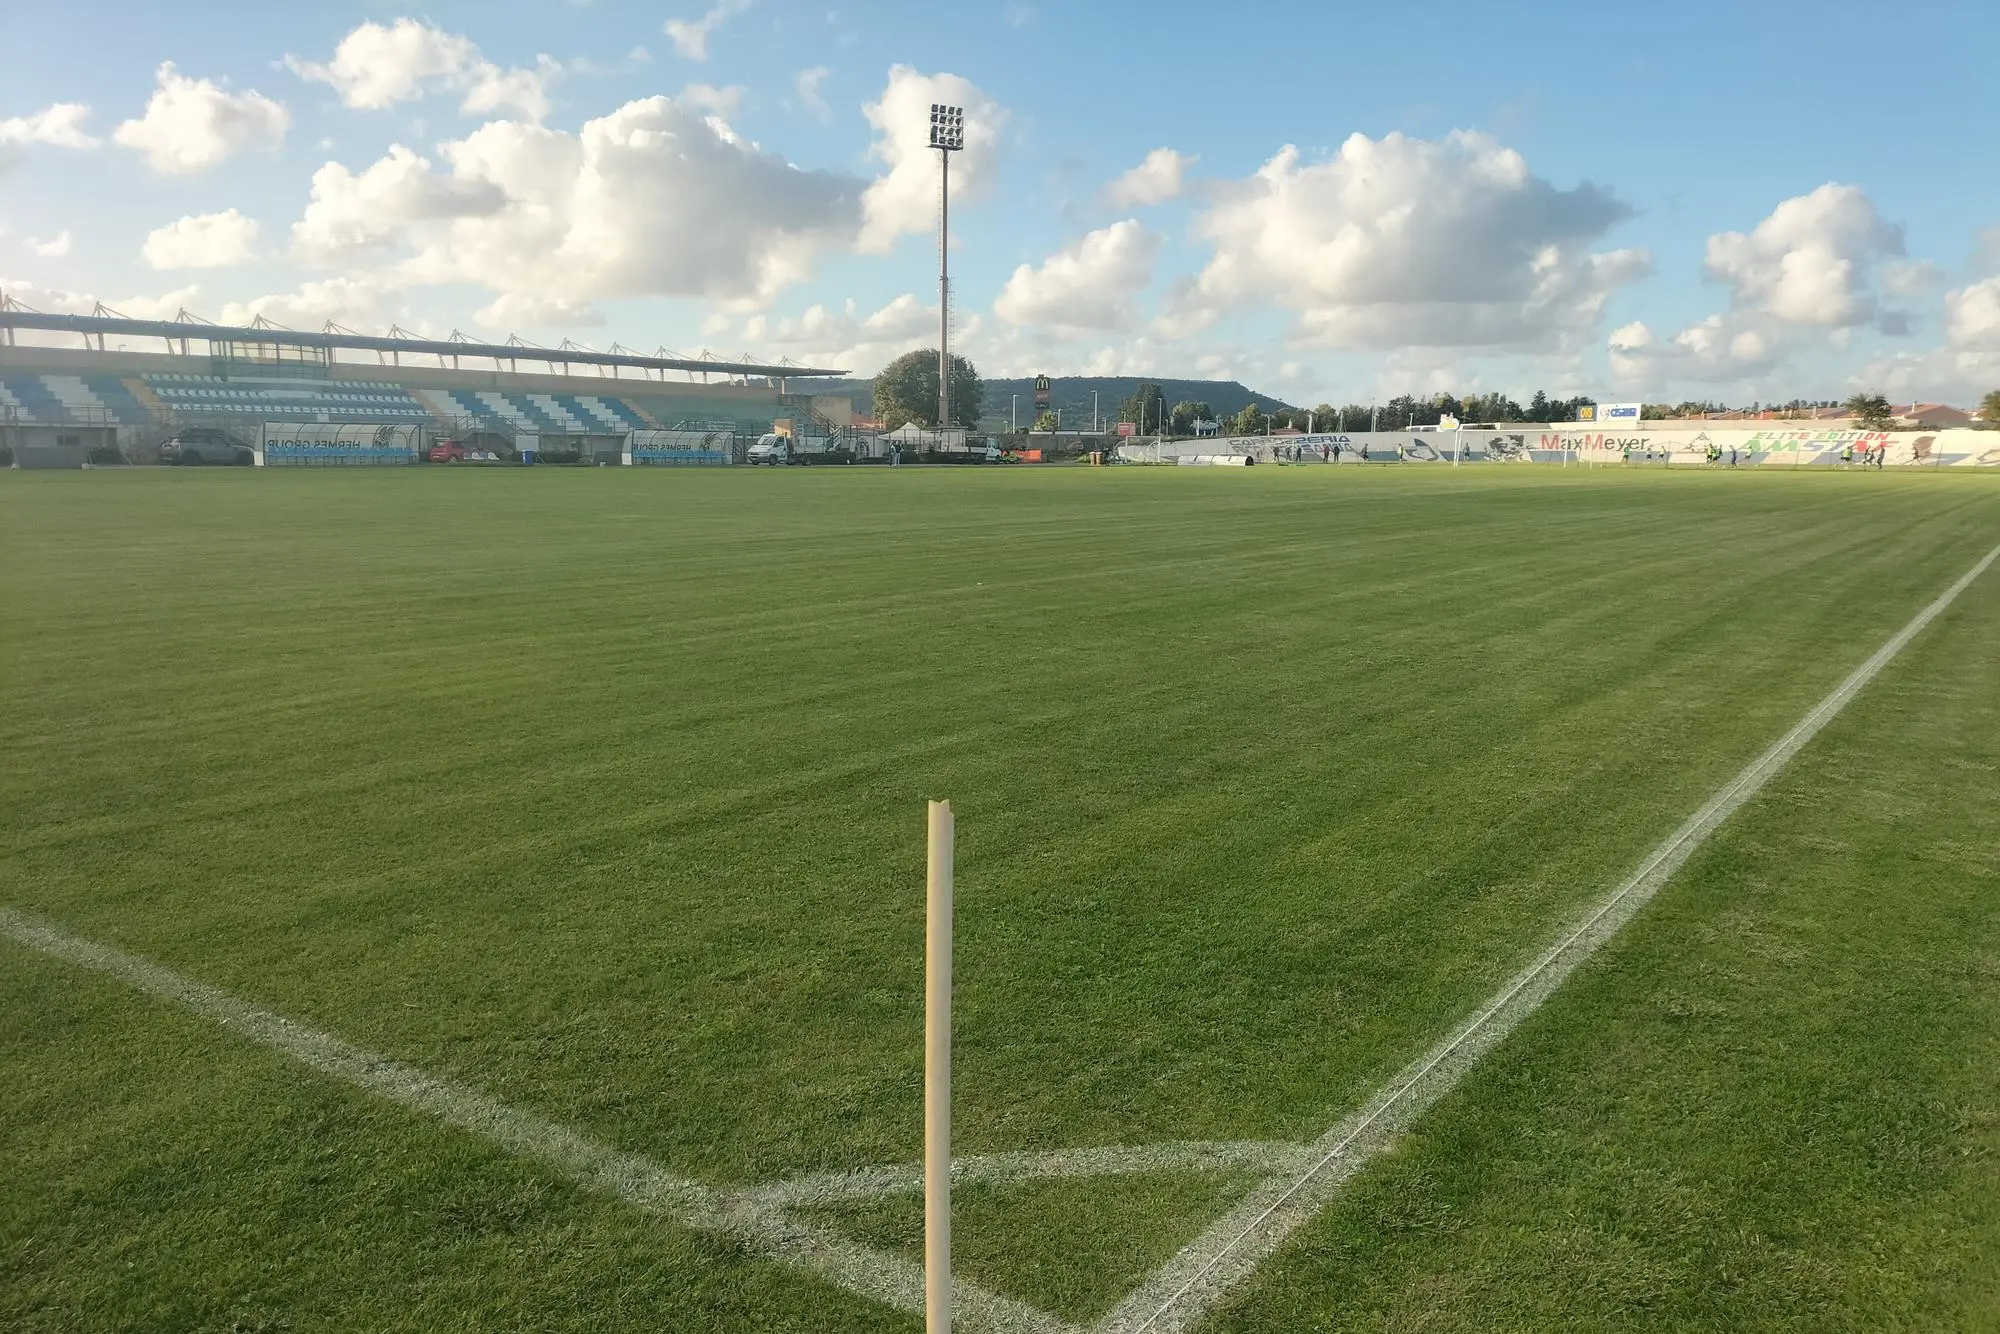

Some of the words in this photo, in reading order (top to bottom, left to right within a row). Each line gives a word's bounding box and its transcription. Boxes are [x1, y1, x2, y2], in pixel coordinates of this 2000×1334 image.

[1753, 432, 1811, 440] ELITE
[1815, 432, 1891, 440] EDITION
[1540, 434, 1650, 451] MaxMeyer
